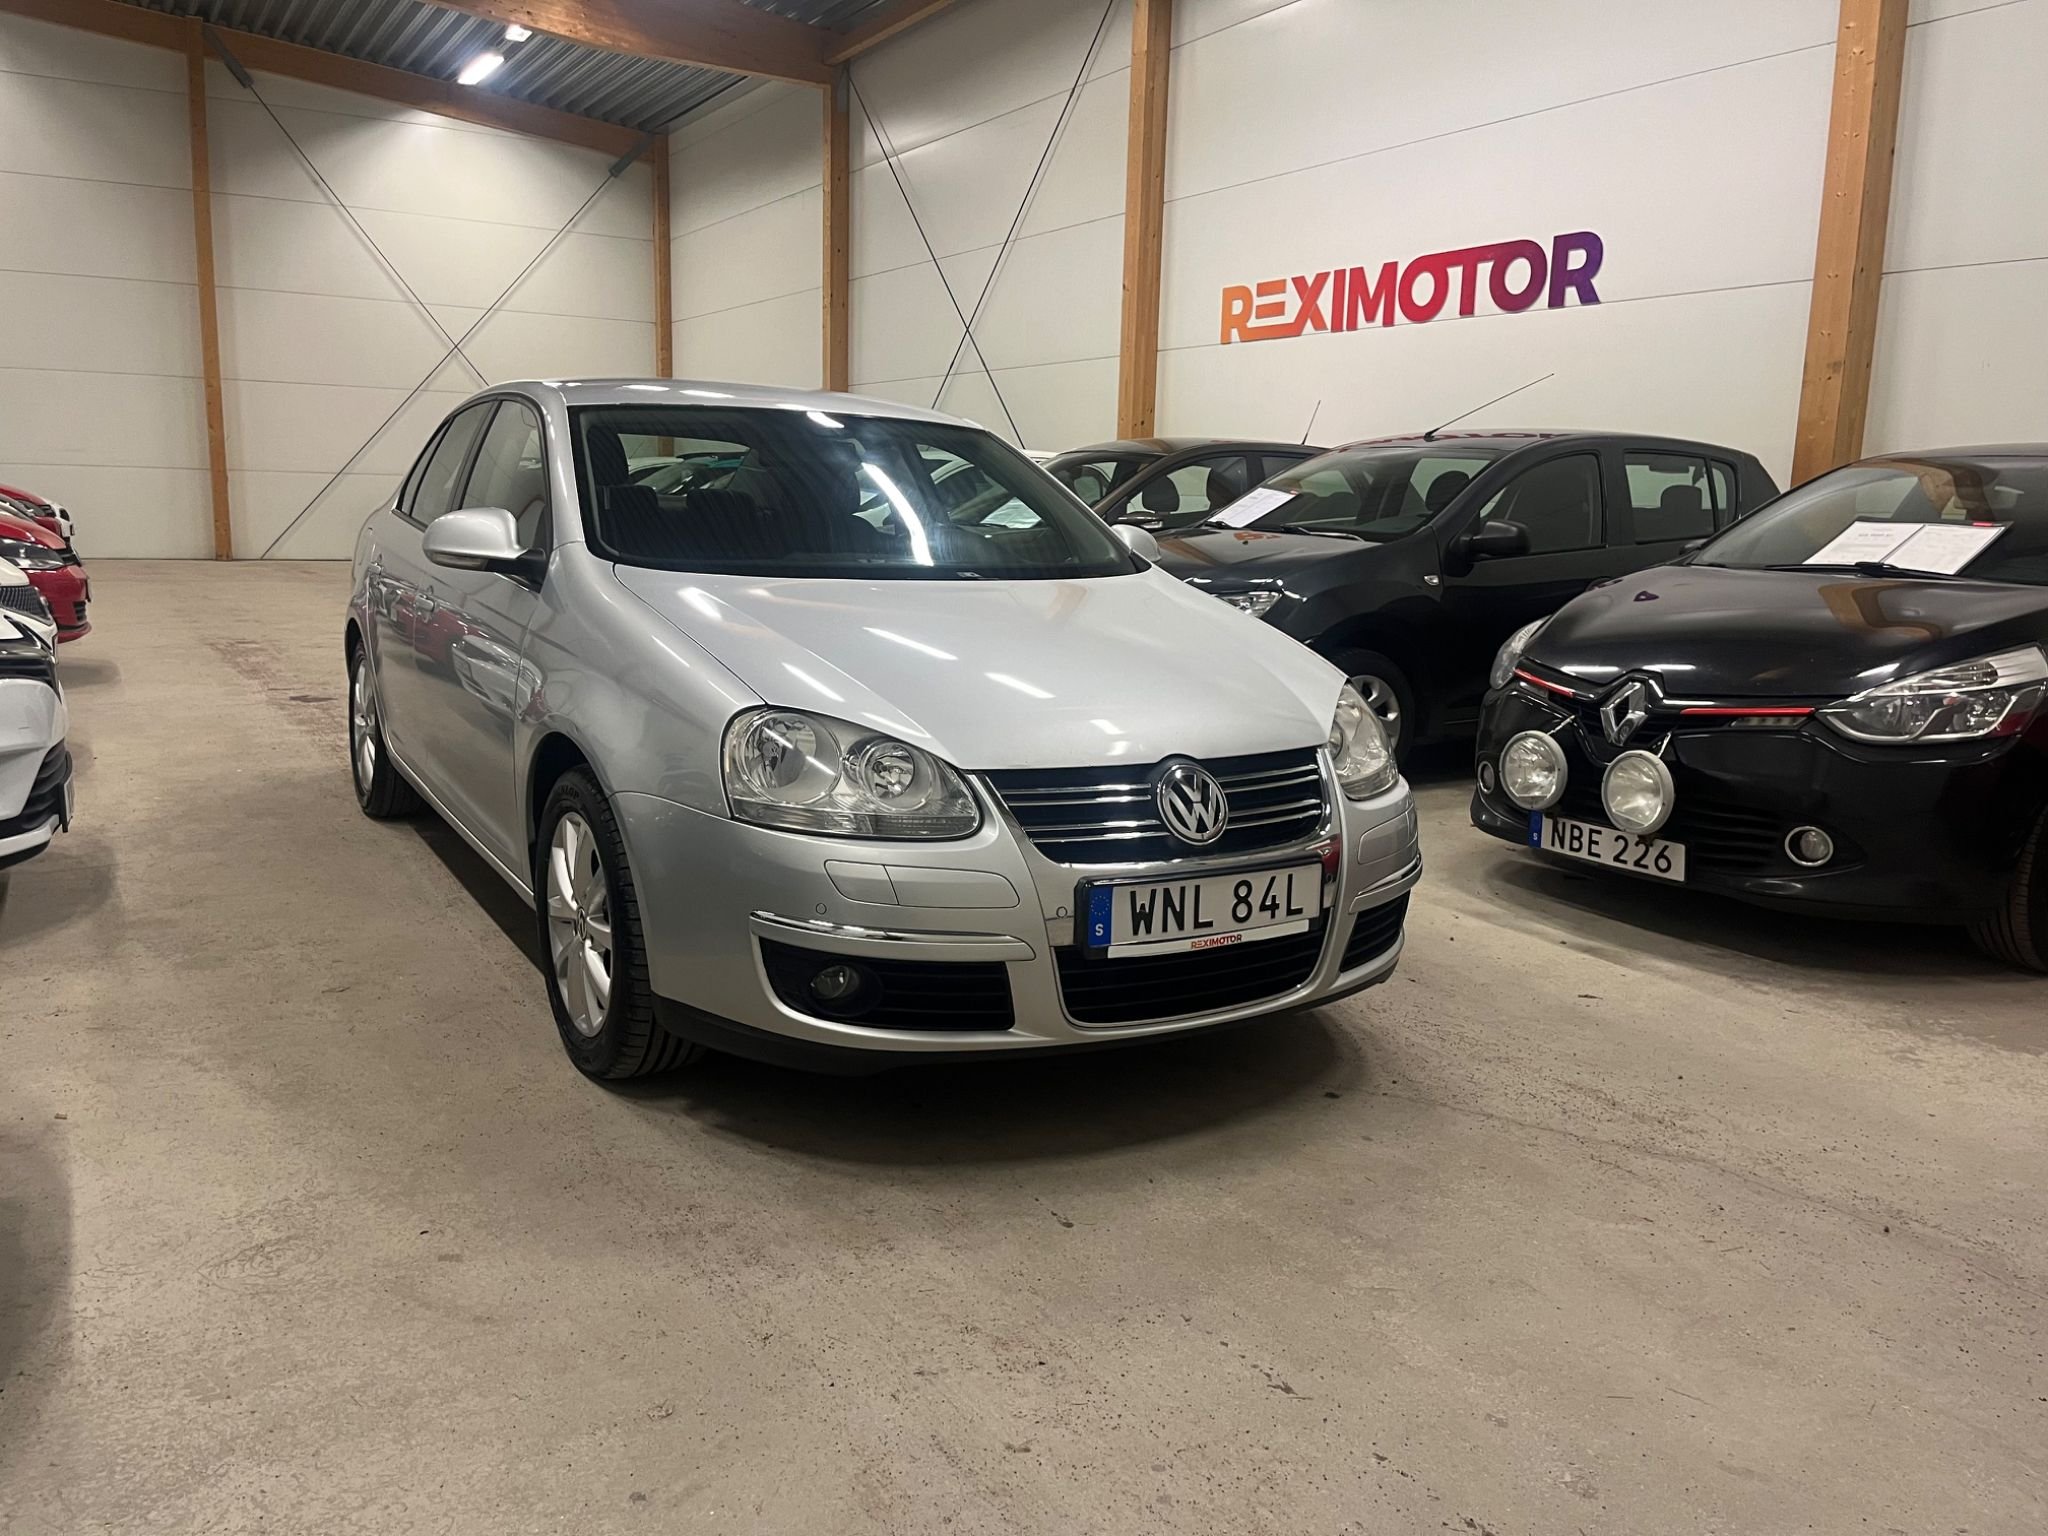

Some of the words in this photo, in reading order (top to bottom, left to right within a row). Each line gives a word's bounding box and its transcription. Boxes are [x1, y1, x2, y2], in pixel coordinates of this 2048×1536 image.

[1220, 231, 1603, 345] REXIMOTOR
[1551, 820, 1603, 858] NBE
[1613, 835, 1672, 874] 226
[1095, 923, 1104, 937] S
[1130, 885, 1214, 937] WNL
[1231, 873, 1304, 924] 84L
[1191, 934, 1242, 949] REXIMOTOR
